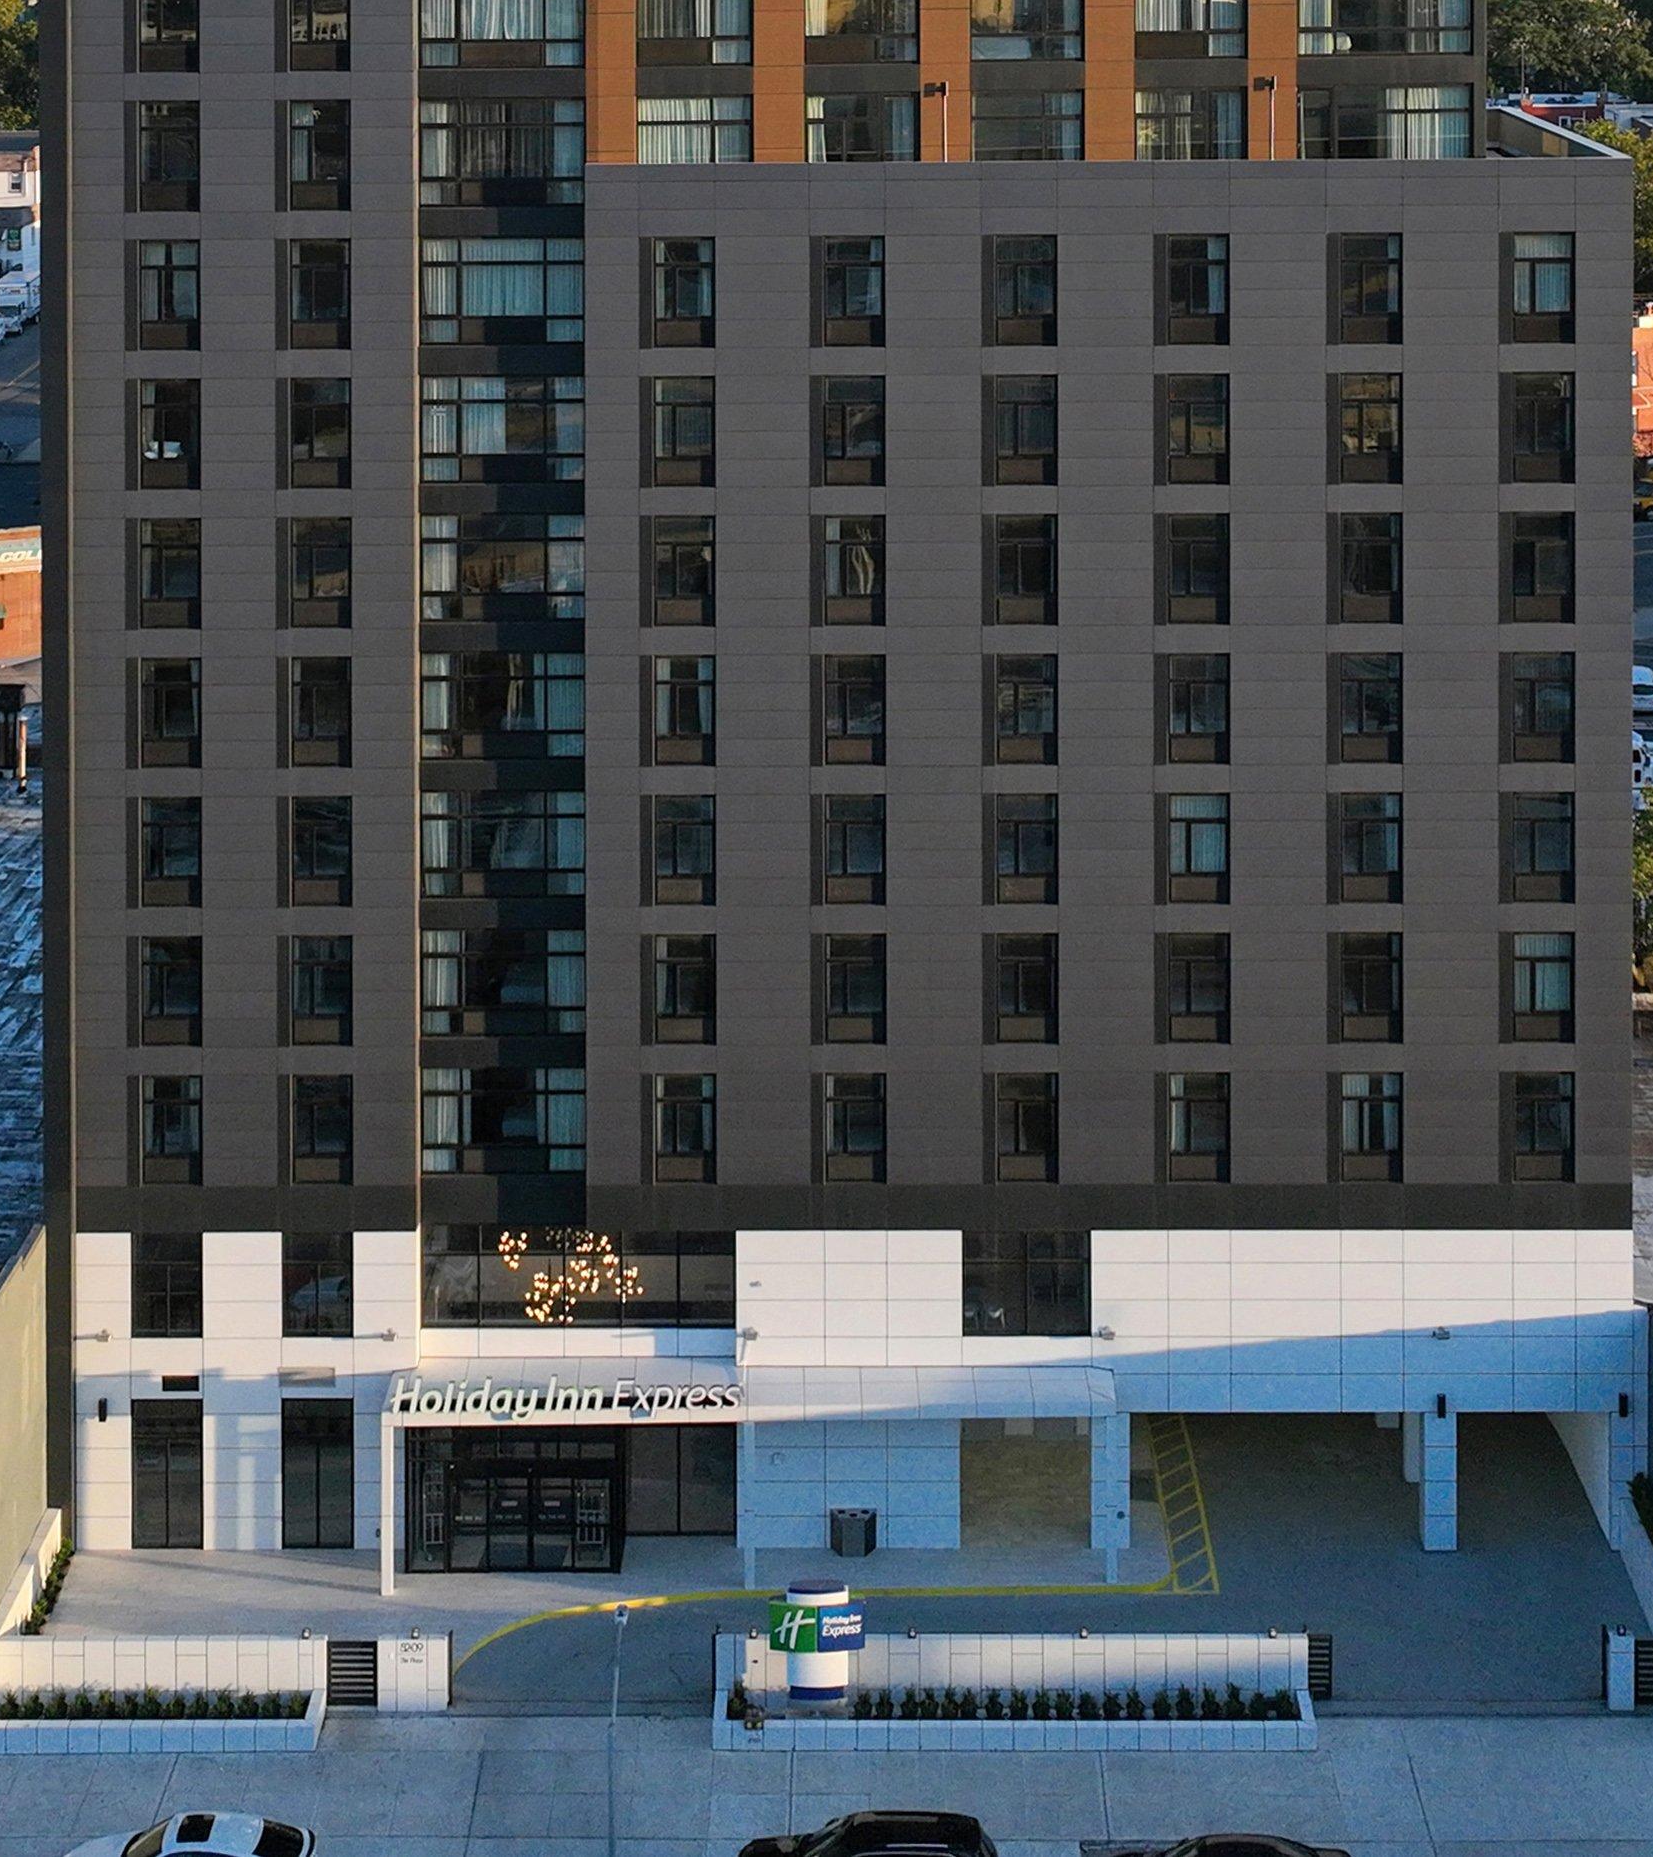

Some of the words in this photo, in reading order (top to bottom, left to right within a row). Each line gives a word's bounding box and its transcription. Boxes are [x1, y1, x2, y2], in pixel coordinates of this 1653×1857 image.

[390, 1376, 546, 1420] Holiday
[544, 1374, 603, 1412] Inn
[610, 1378, 741, 1419] Express
[822, 1624, 862, 1638] Express
